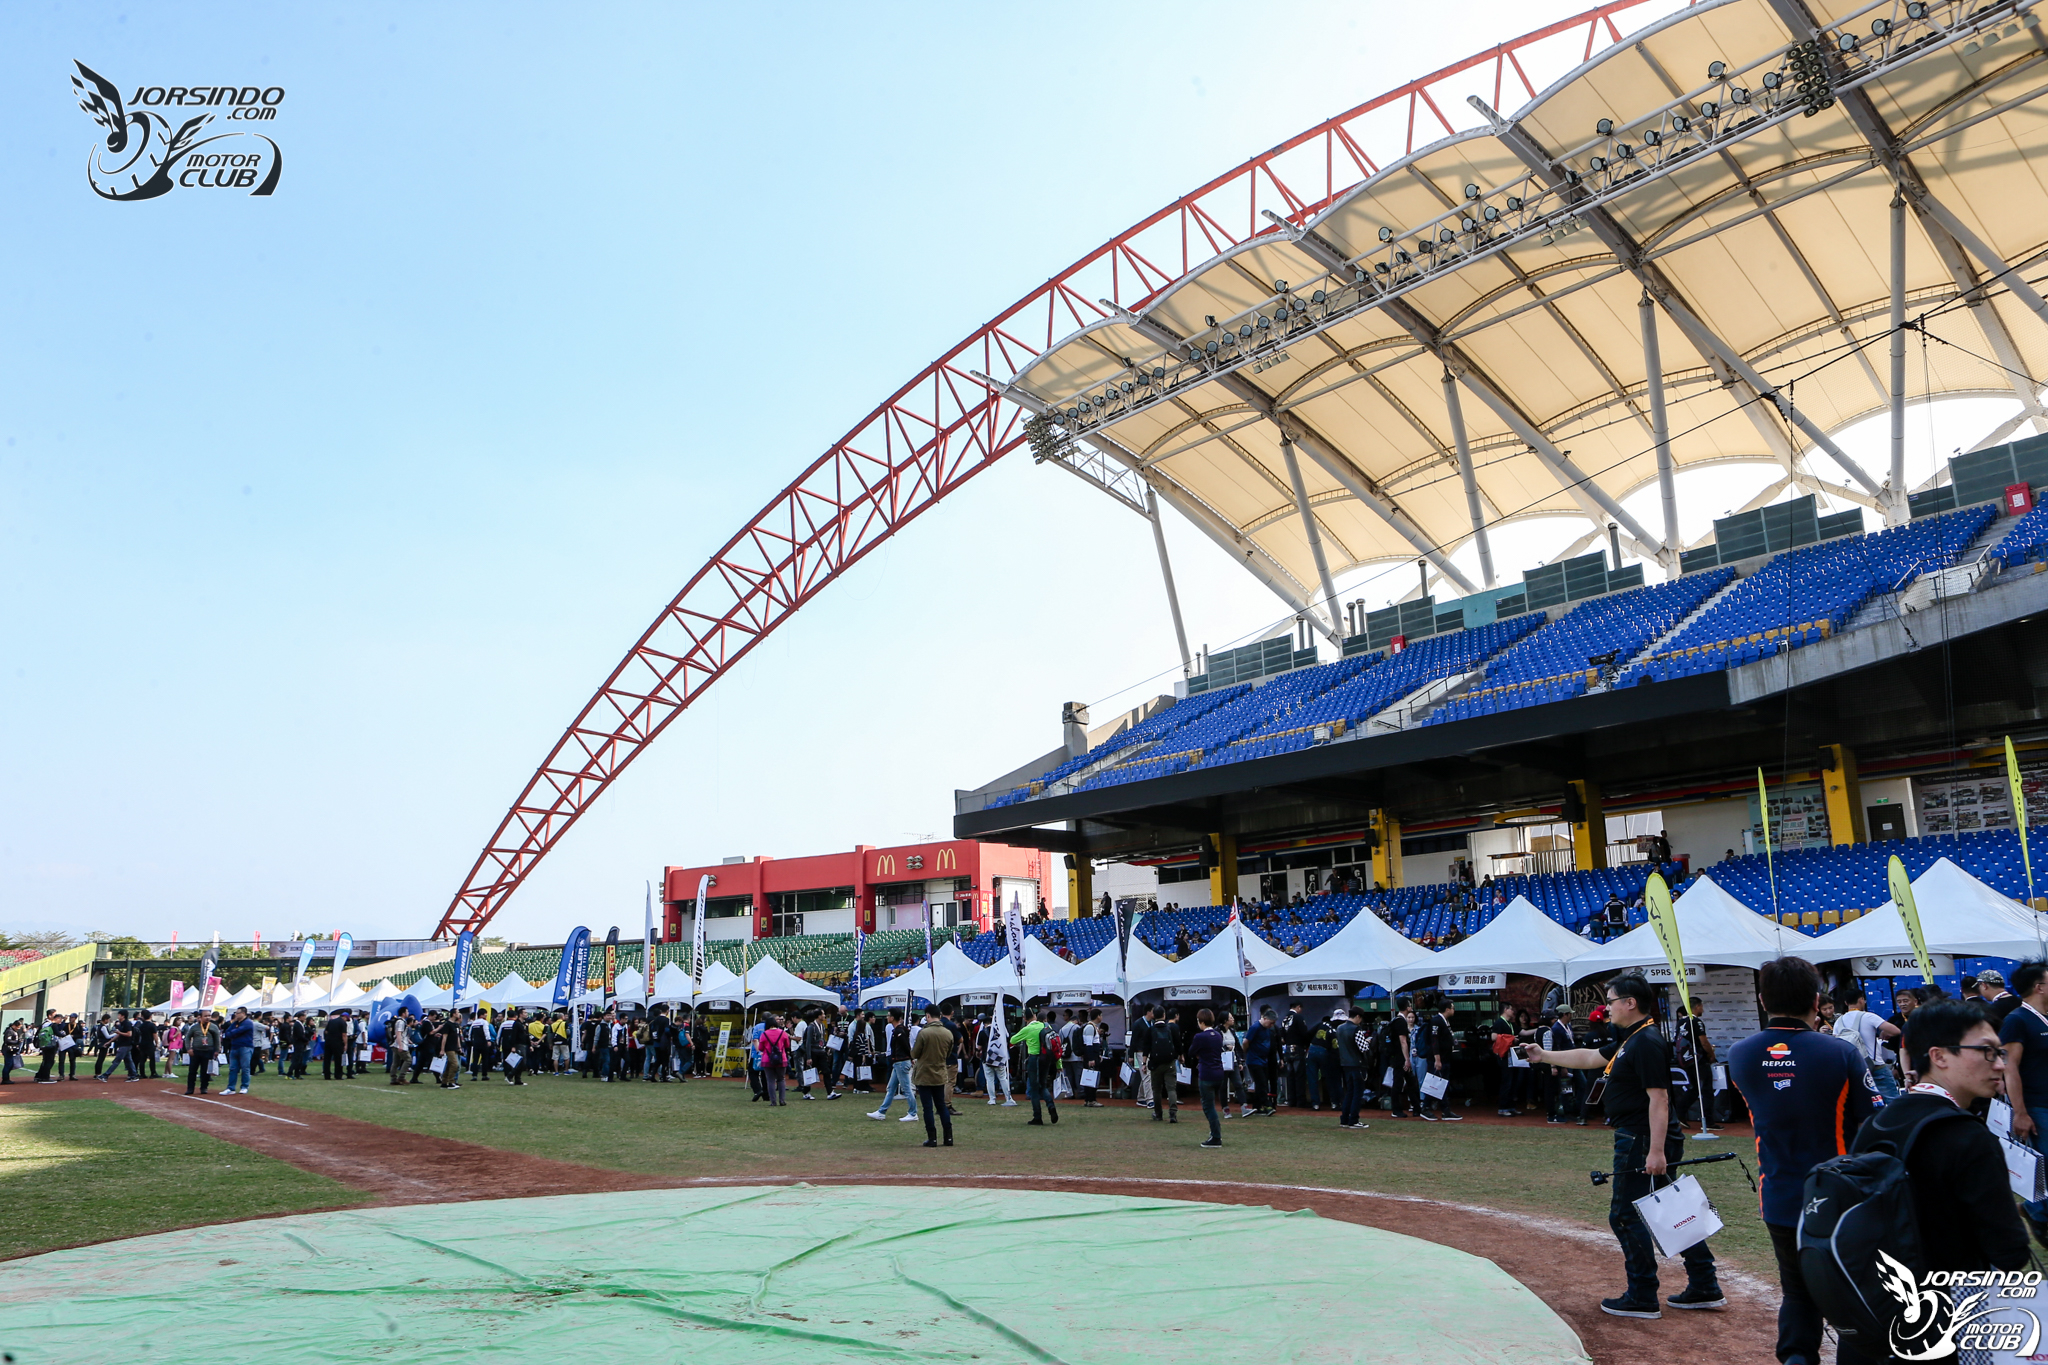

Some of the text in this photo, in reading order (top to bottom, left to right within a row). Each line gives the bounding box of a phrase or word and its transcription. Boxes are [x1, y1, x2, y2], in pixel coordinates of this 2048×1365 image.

[459, 940, 470, 987] MICHELIN
[1892, 959, 1936, 968] MACA
[574, 947, 584, 997] METZELER
[1651, 967, 1672, 976] SPRS
[1673, 1214, 1697, 1229] HONDA
